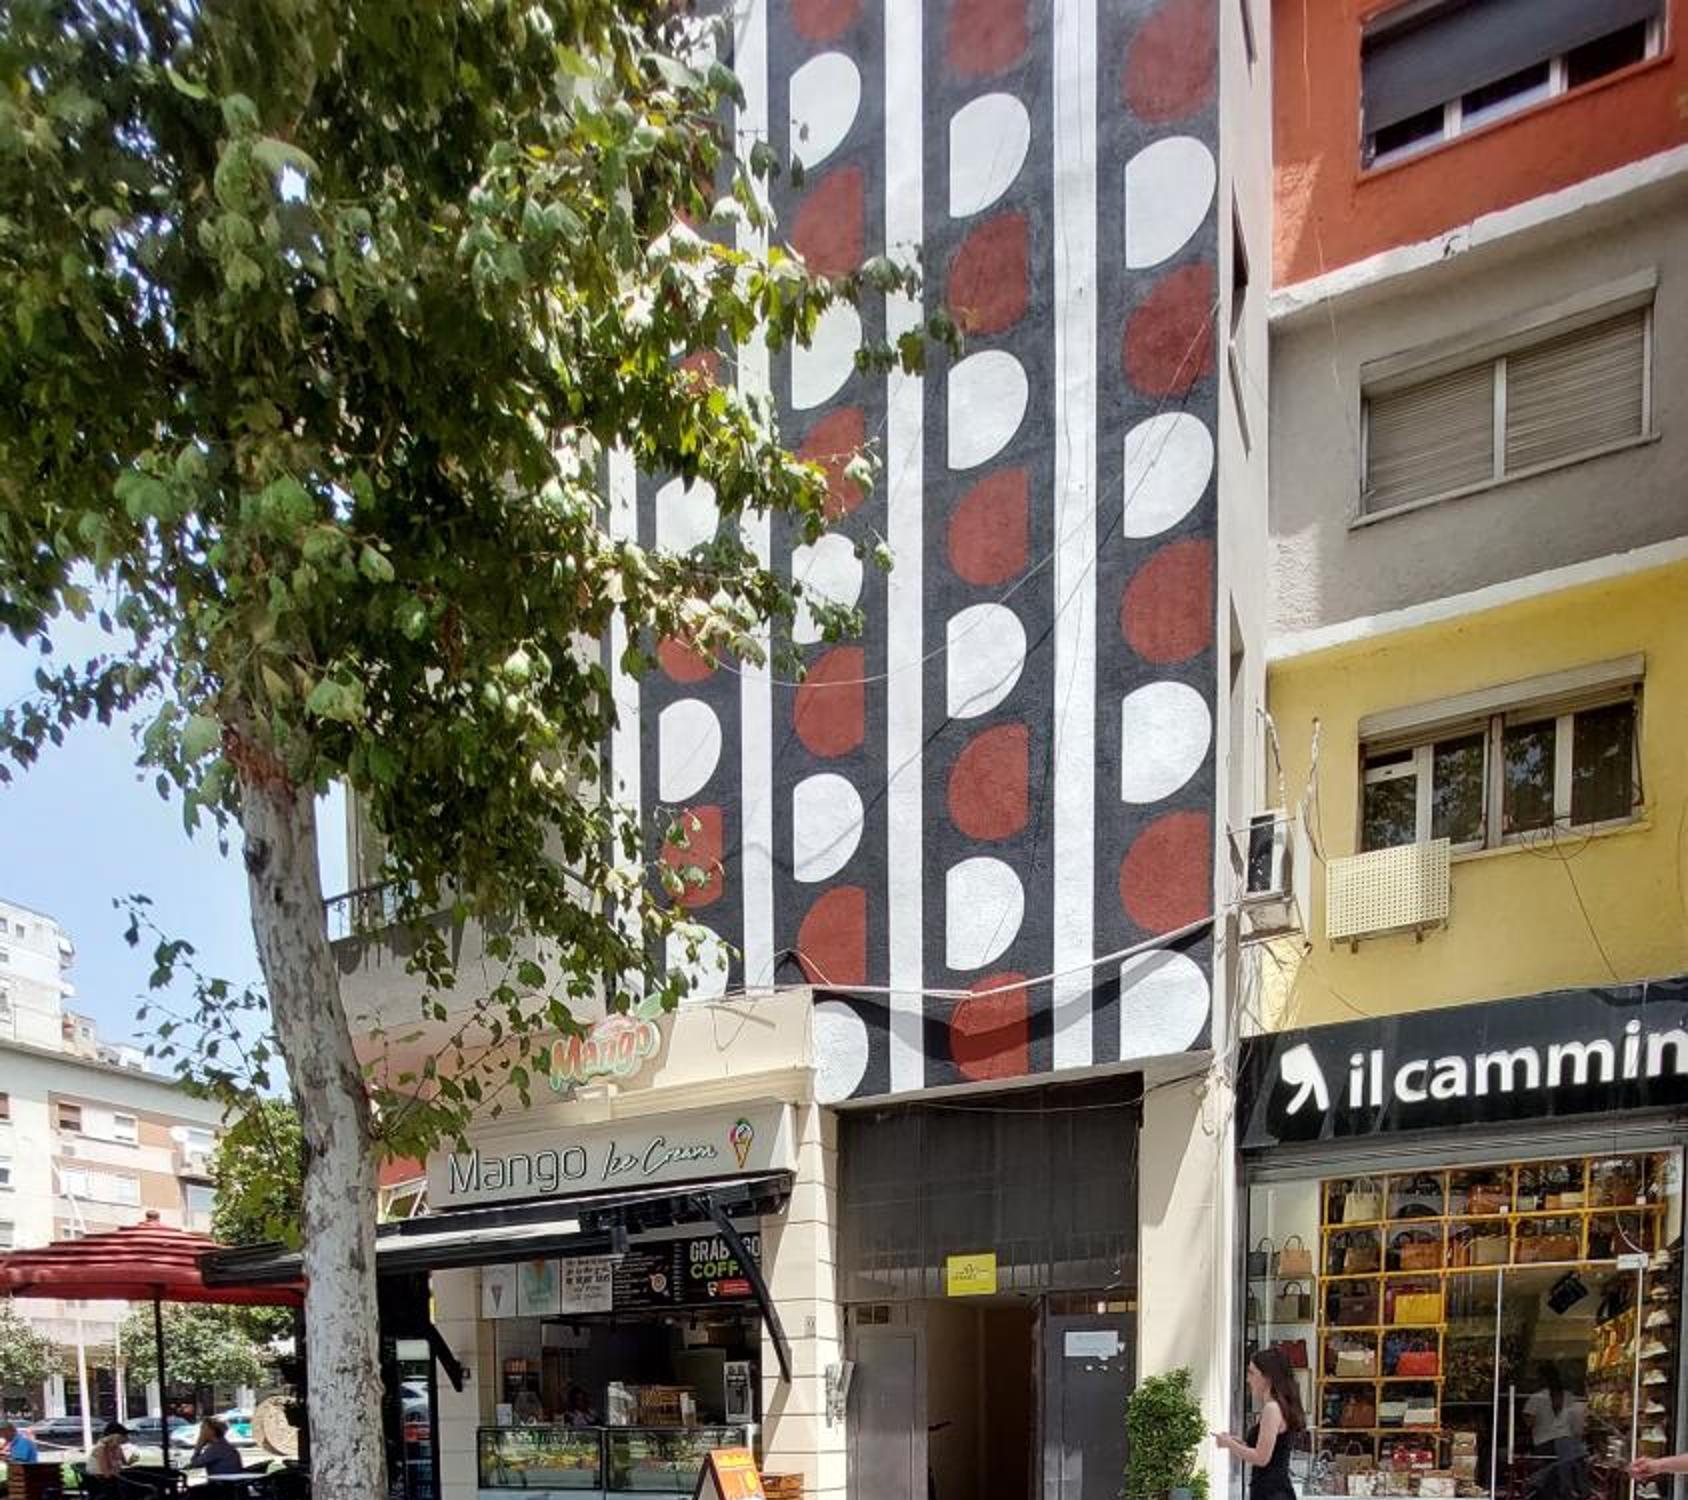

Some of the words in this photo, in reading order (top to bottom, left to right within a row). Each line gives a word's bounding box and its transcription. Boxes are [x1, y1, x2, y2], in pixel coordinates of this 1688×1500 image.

[549, 1022, 661, 1090] Mango
[1350, 1049, 1384, 1108] il
[448, 1145, 587, 1195] Mango
[601, 1141, 638, 1180] Ice
[641, 1136, 718, 1176] Cream
